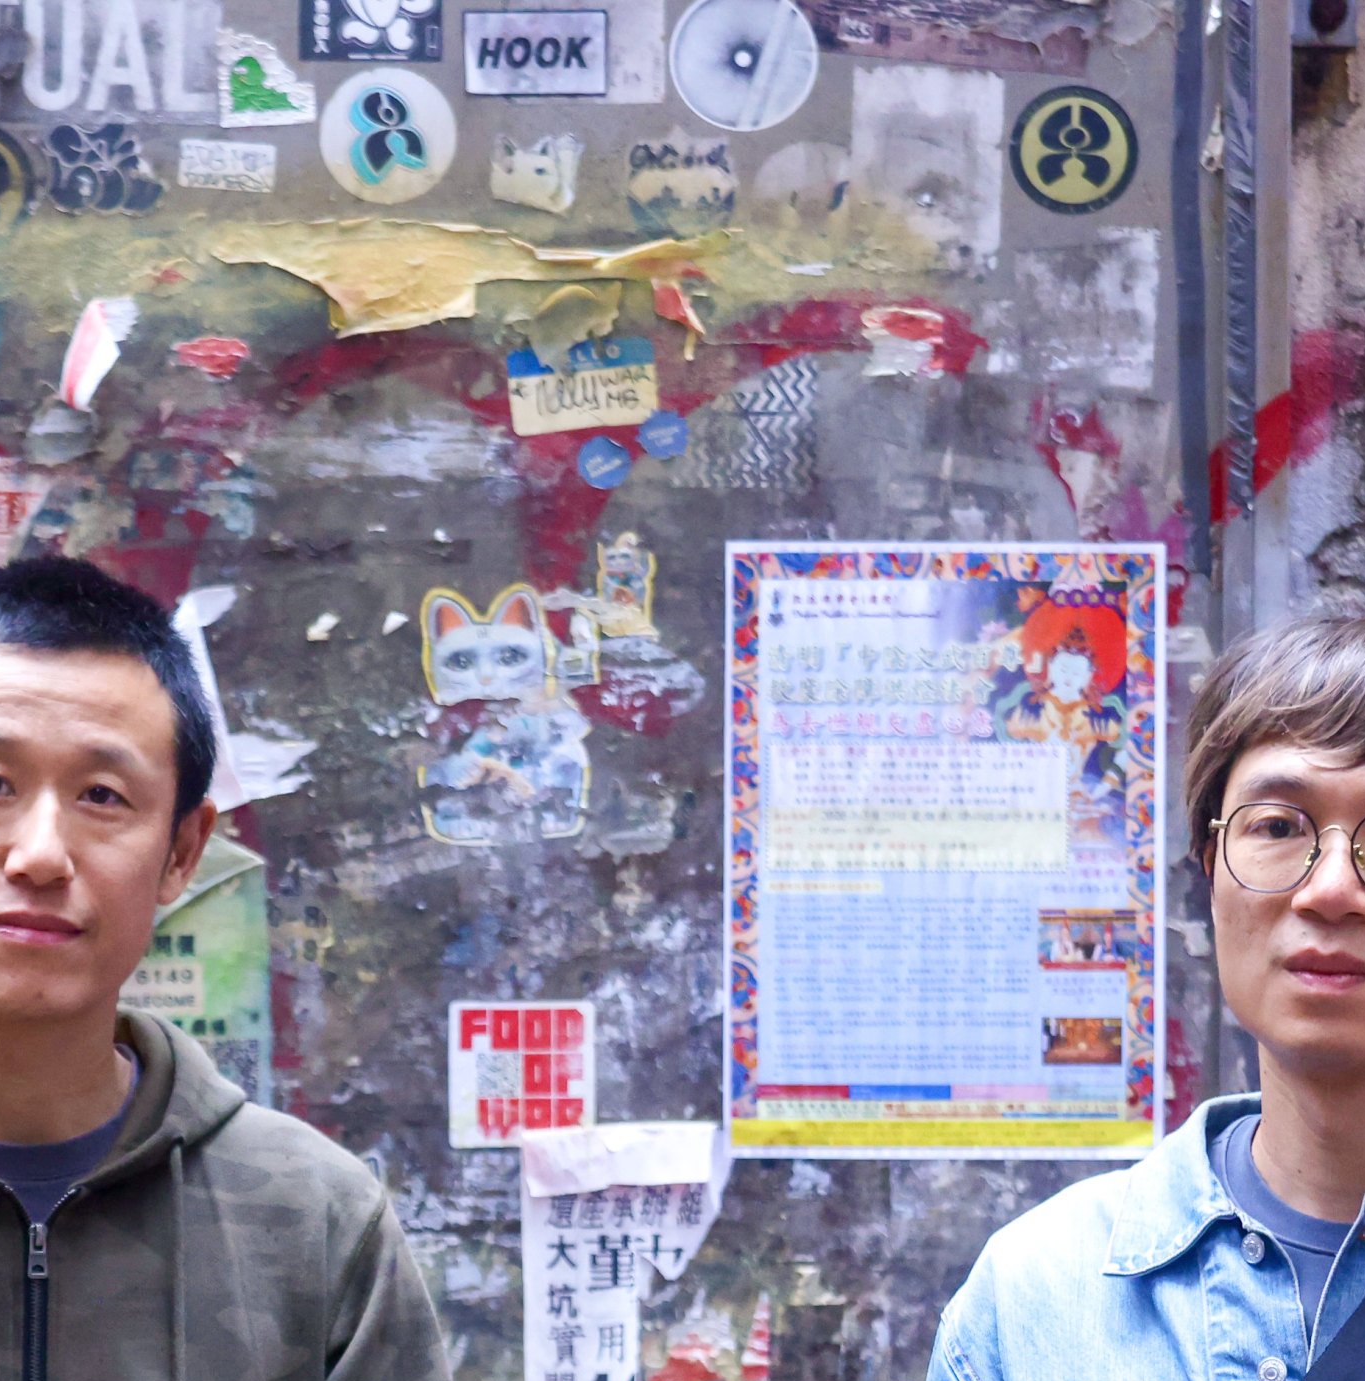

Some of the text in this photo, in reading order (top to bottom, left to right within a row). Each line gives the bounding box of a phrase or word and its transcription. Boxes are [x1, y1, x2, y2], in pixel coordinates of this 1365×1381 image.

[477, 36, 592, 69] HOOK
[460, 1009, 584, 1051] FOOD
[523, 1053, 584, 1095] OF
